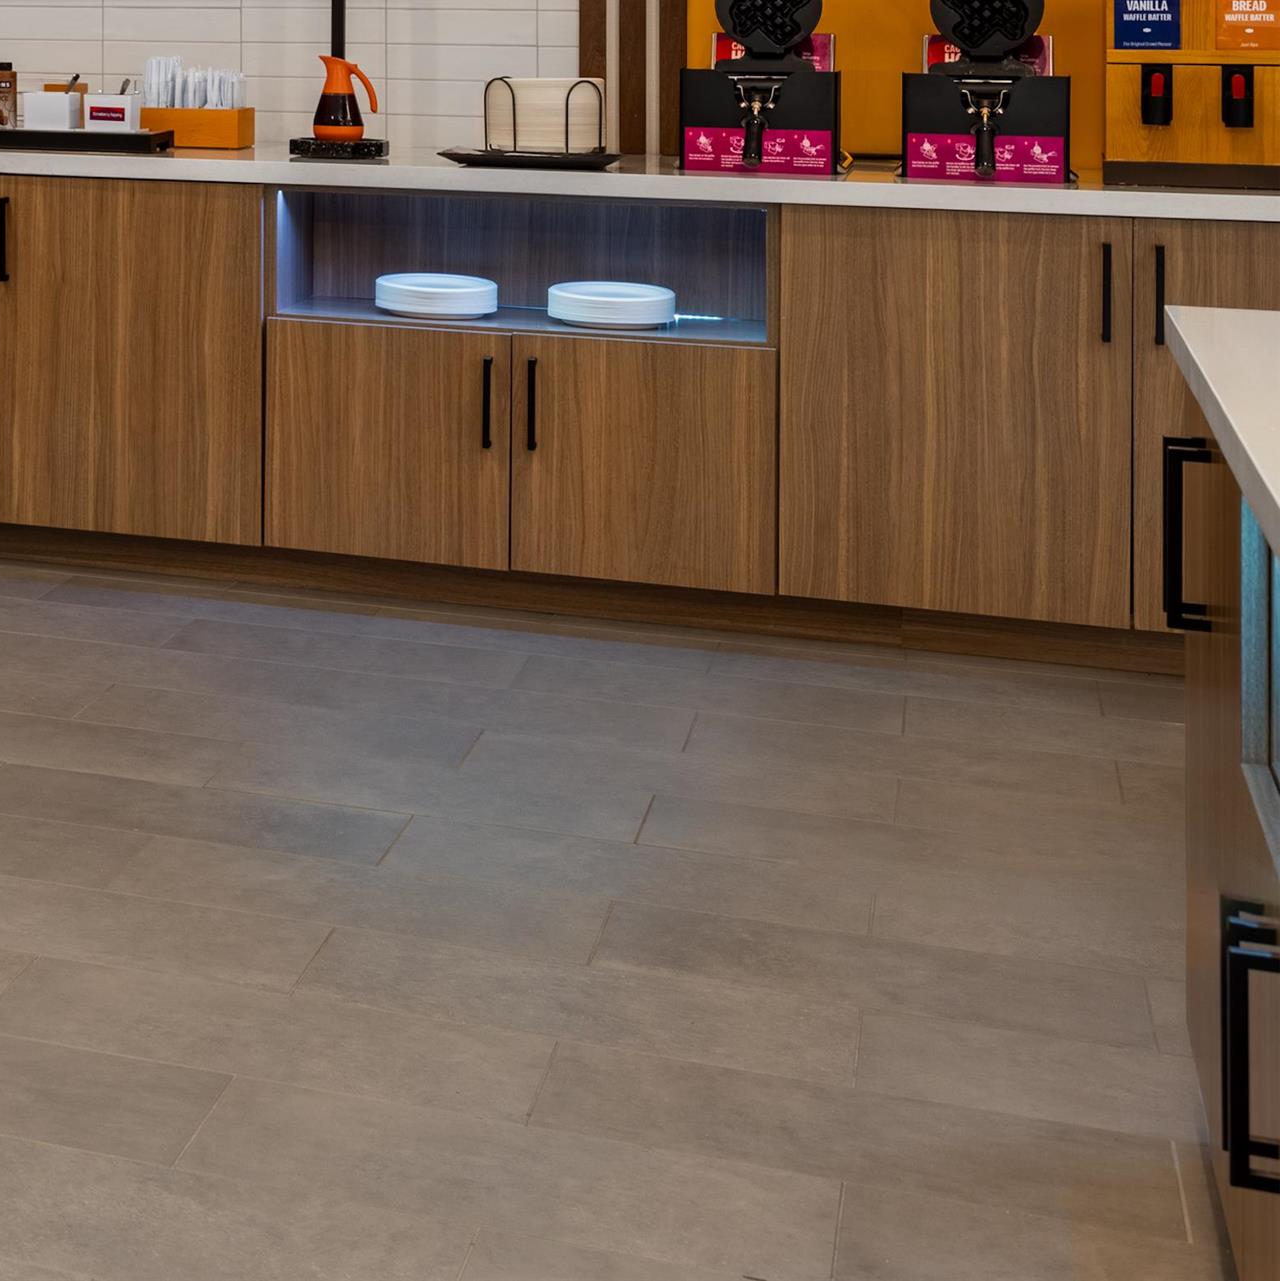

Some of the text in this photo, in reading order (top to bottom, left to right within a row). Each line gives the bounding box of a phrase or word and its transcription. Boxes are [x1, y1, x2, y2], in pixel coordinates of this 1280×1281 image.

[1126, 0, 1168, 11] VANILLA
[1232, 0, 1267, 11] BREAD
[1123, 13, 1172, 21] WAFFLE BATTER
[1224, 13, 1248, 21] WAFFLE
